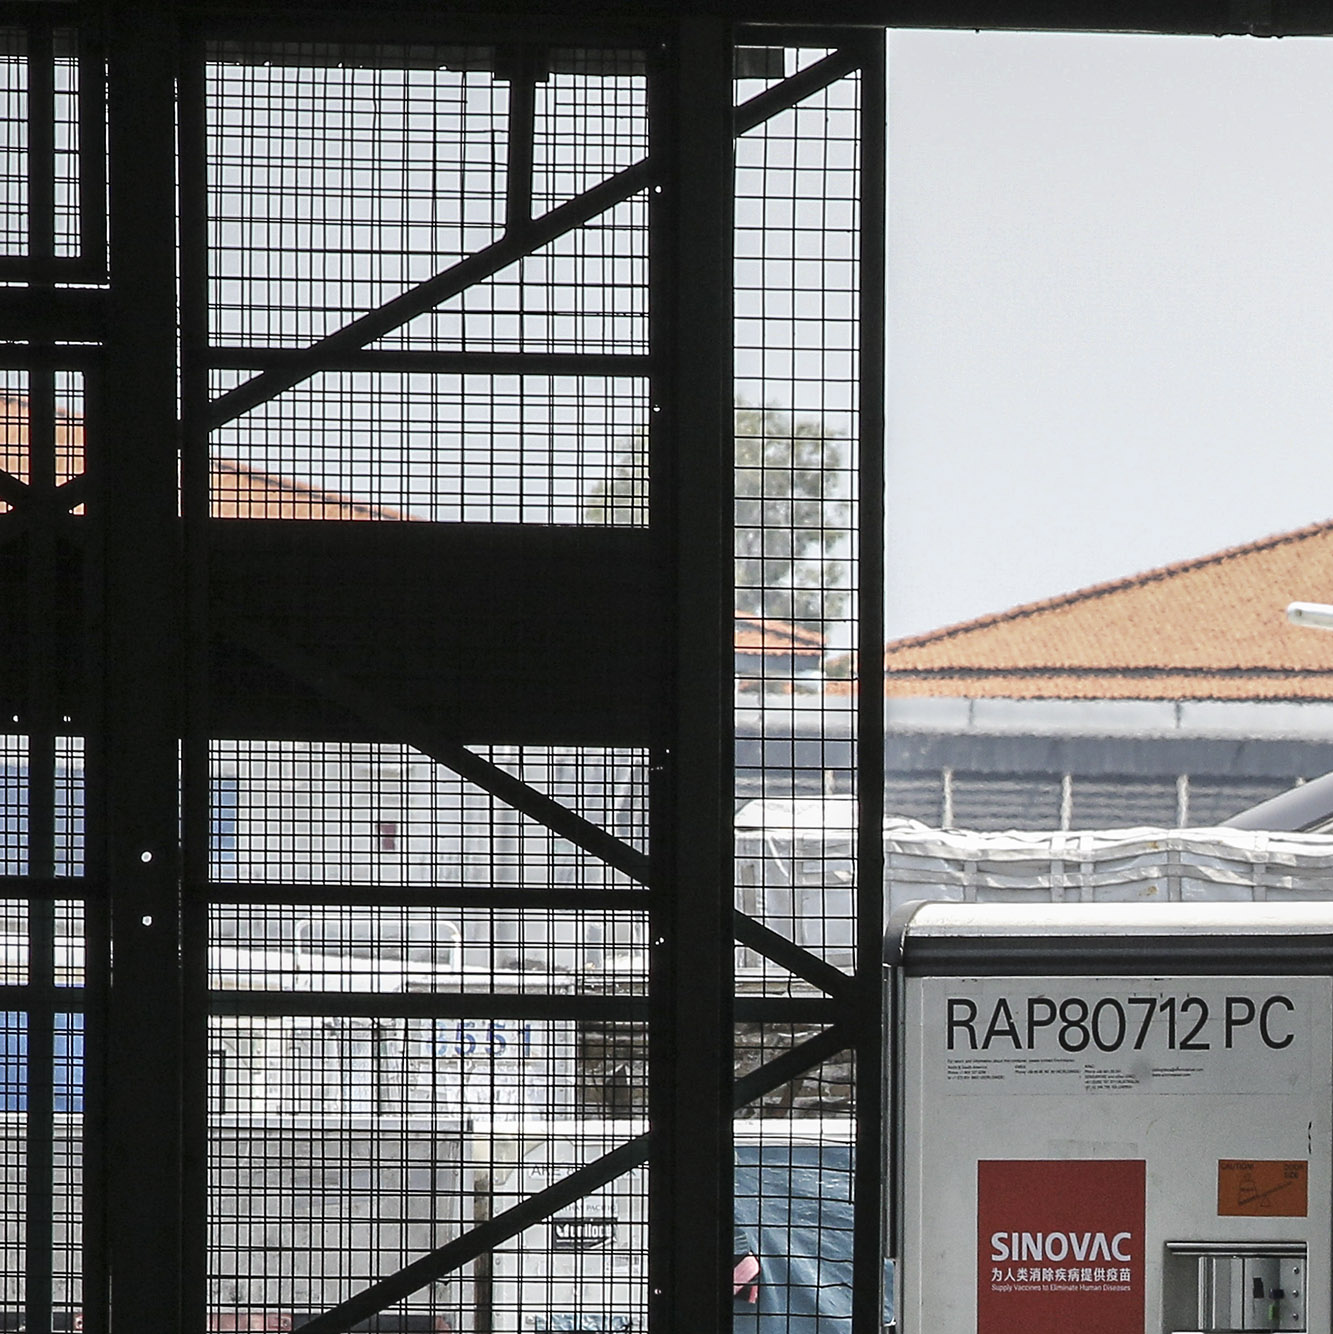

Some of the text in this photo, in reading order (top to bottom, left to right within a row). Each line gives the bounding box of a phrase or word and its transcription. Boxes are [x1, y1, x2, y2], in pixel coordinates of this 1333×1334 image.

[946, 994, 1295, 1052] RAP80712 PC
[990, 1231, 1132, 1262] SINOVAC
[991, 1267, 1131, 1282] 为人类消除疾病提供疫苗
